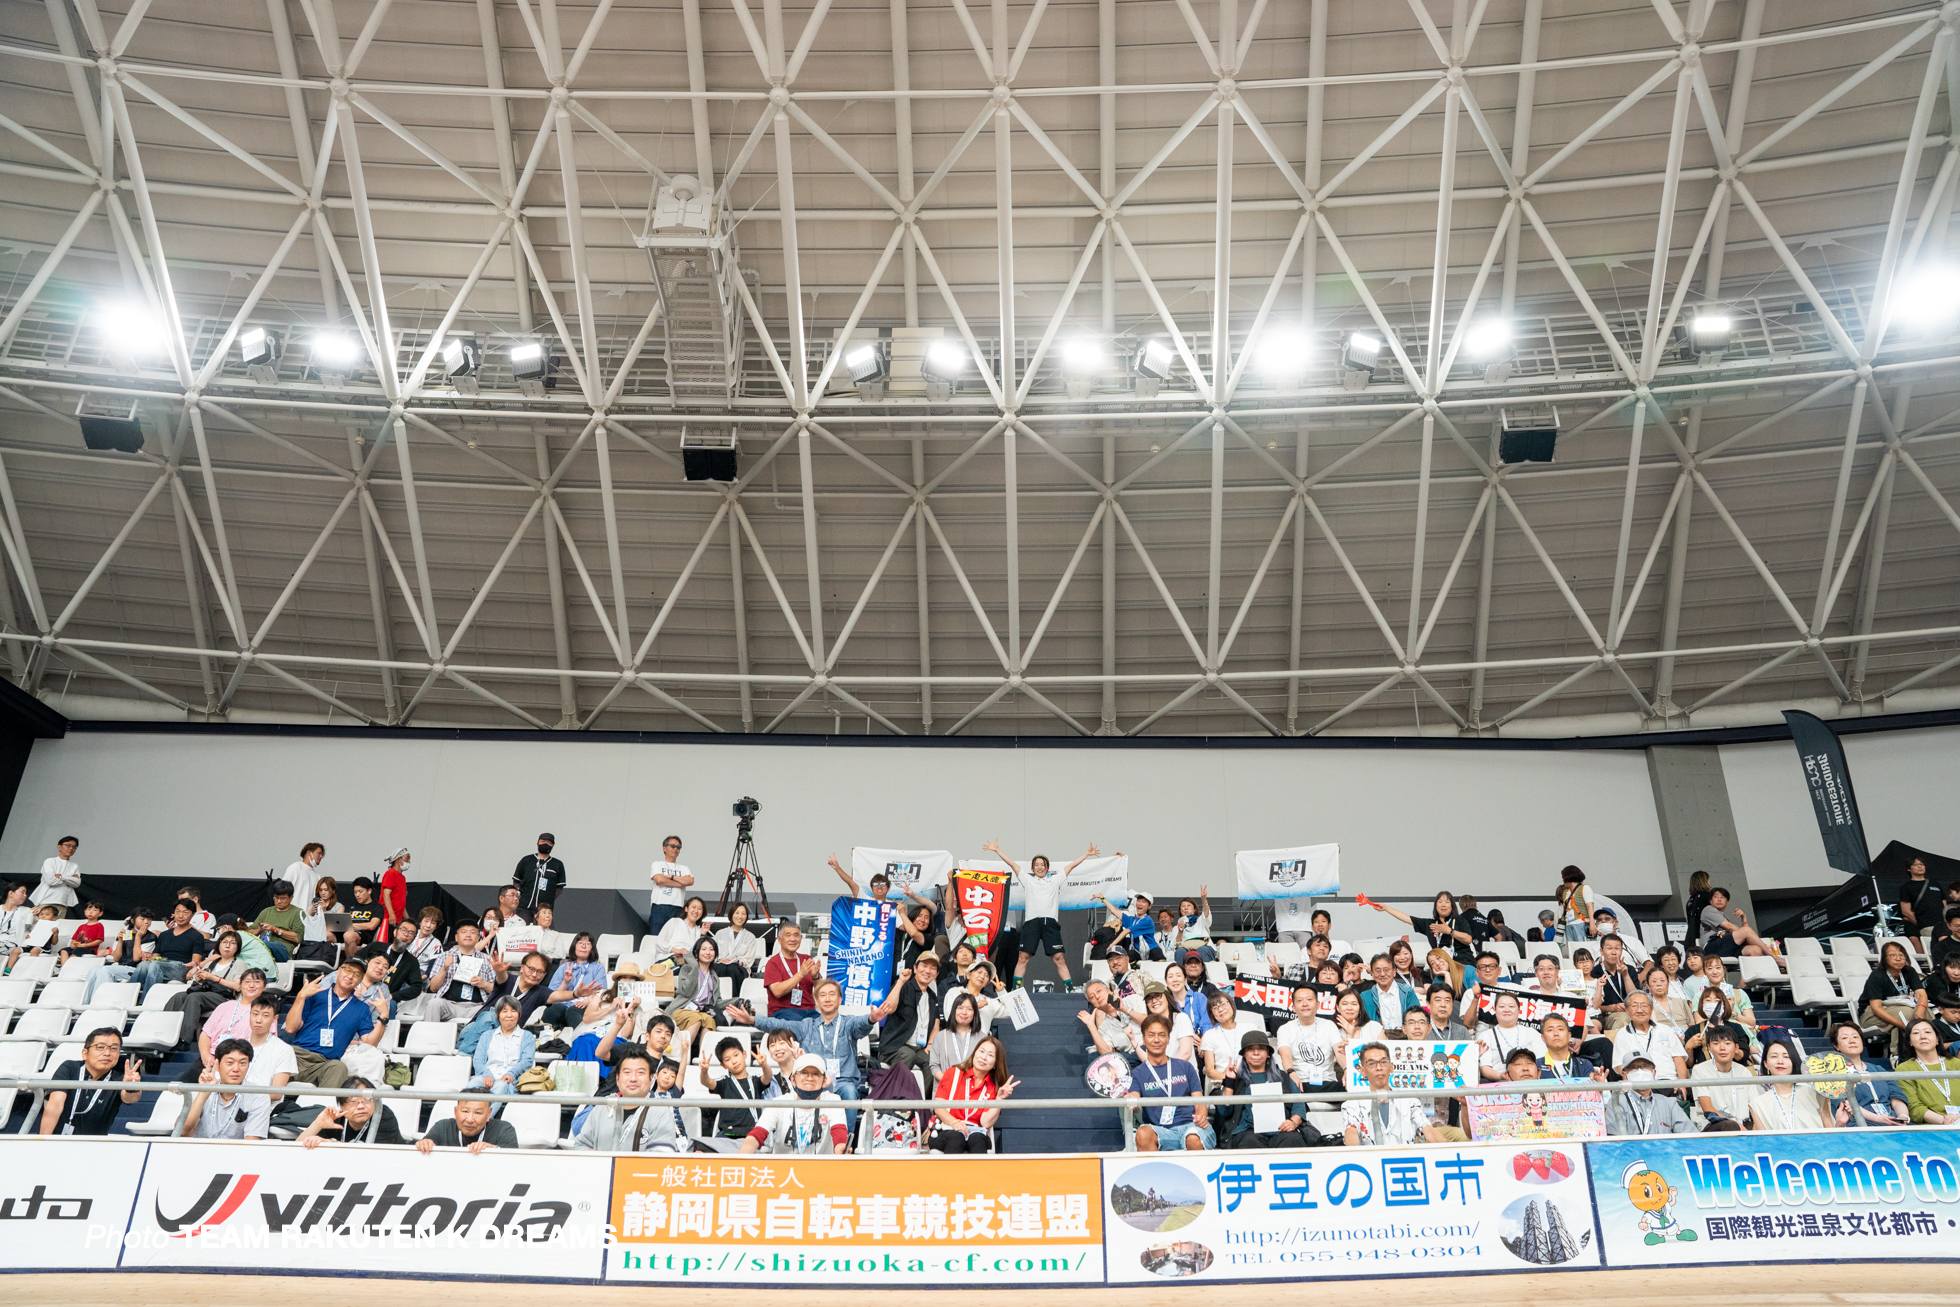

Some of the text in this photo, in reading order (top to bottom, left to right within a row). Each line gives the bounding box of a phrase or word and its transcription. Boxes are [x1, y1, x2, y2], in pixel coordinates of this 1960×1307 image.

[848, 951, 884, 965] NAKANO
[632, 1164, 805, 1189] 一般社団法人
[1207, 1152, 1485, 1214] 伊豆の国市
[1682, 1151, 1960, 1208] Welcome to
[622, 1191, 1090, 1240] 静岡県自転車競技連盟
[1225, 1220, 1480, 1247] http://izunotabi.com/
[622, 1250, 1087, 1276] http://shizuoka-cf.com/
[1225, 1245, 1484, 1265] TEL 055-948-0304
